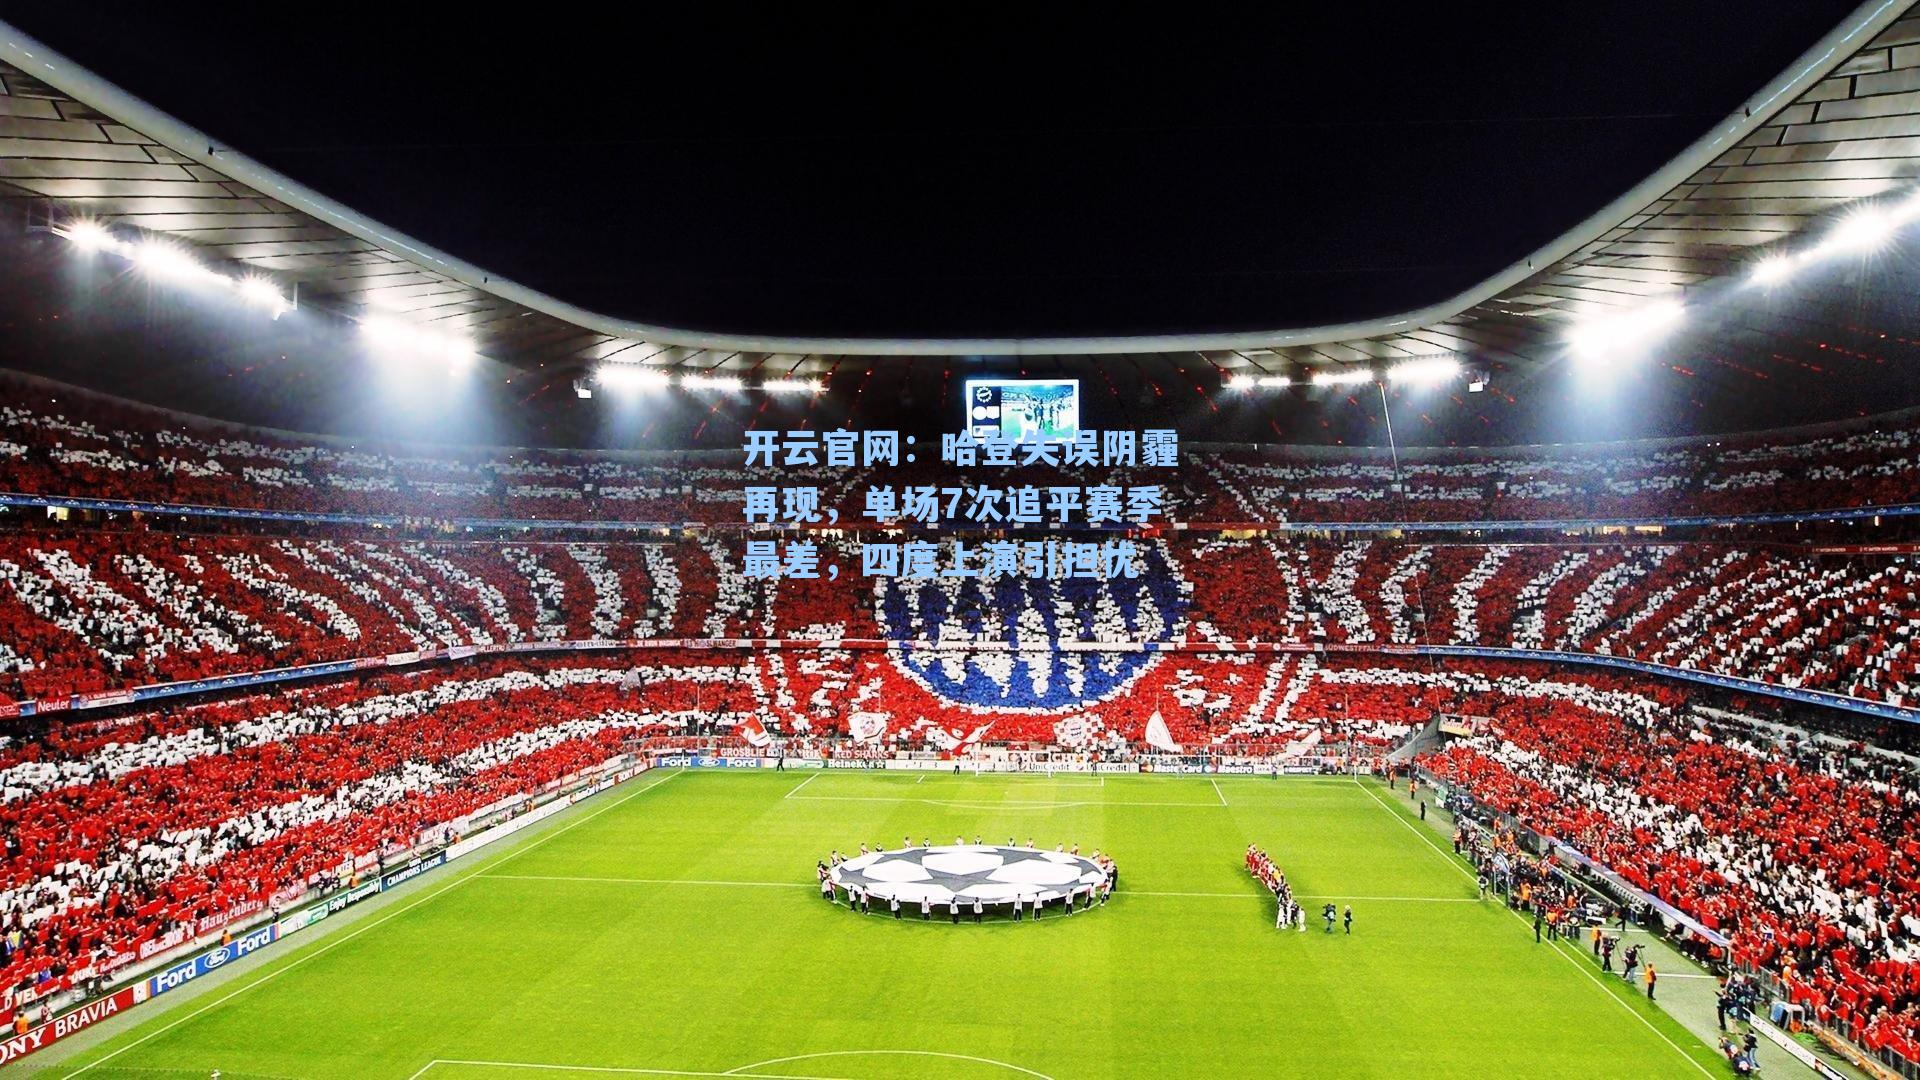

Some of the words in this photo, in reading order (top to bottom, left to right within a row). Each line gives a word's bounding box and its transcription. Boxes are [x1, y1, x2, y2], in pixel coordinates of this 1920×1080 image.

[661, 757, 692, 767] Ford
[726, 757, 757, 768] Ford
[387, 865, 420, 887] CHAMPIONS
[237, 930, 270, 956] Ford
[156, 960, 196, 993] Ford
[55, 997, 118, 1038] BRAVIA
